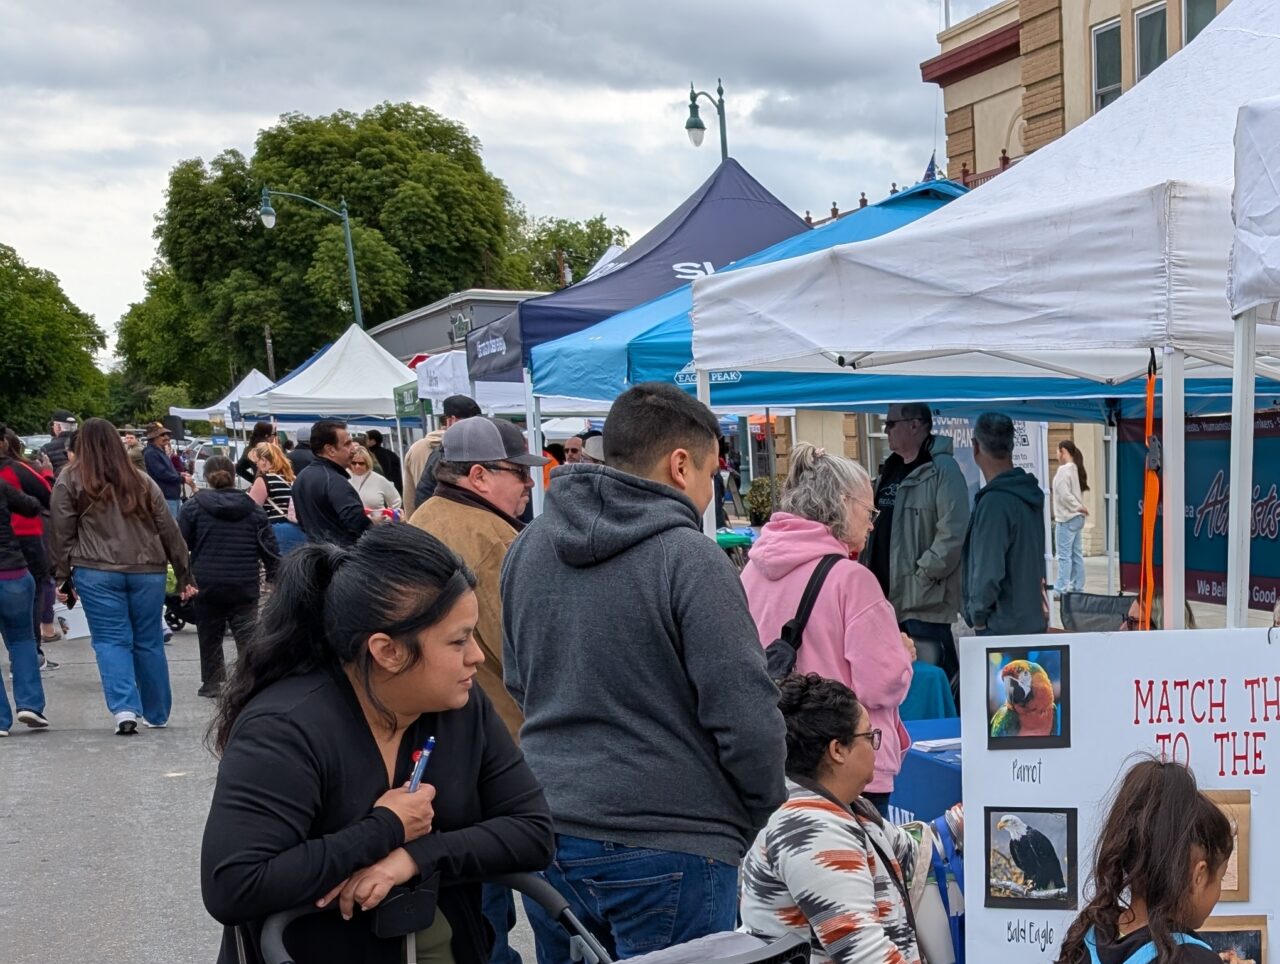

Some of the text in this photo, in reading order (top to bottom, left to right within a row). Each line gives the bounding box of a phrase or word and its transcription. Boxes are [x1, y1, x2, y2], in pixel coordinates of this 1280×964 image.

[711, 371, 737, 381] PEAK
[1197, 580, 1210, 595] We
[1134, 678, 1227, 724] MATCH
[1156, 732, 1190, 770] TO
[1214, 732, 1266, 776] THE
[1012, 757, 1042, 785] Parrot
[1007, 918, 1054, 952] Bald Eagle
